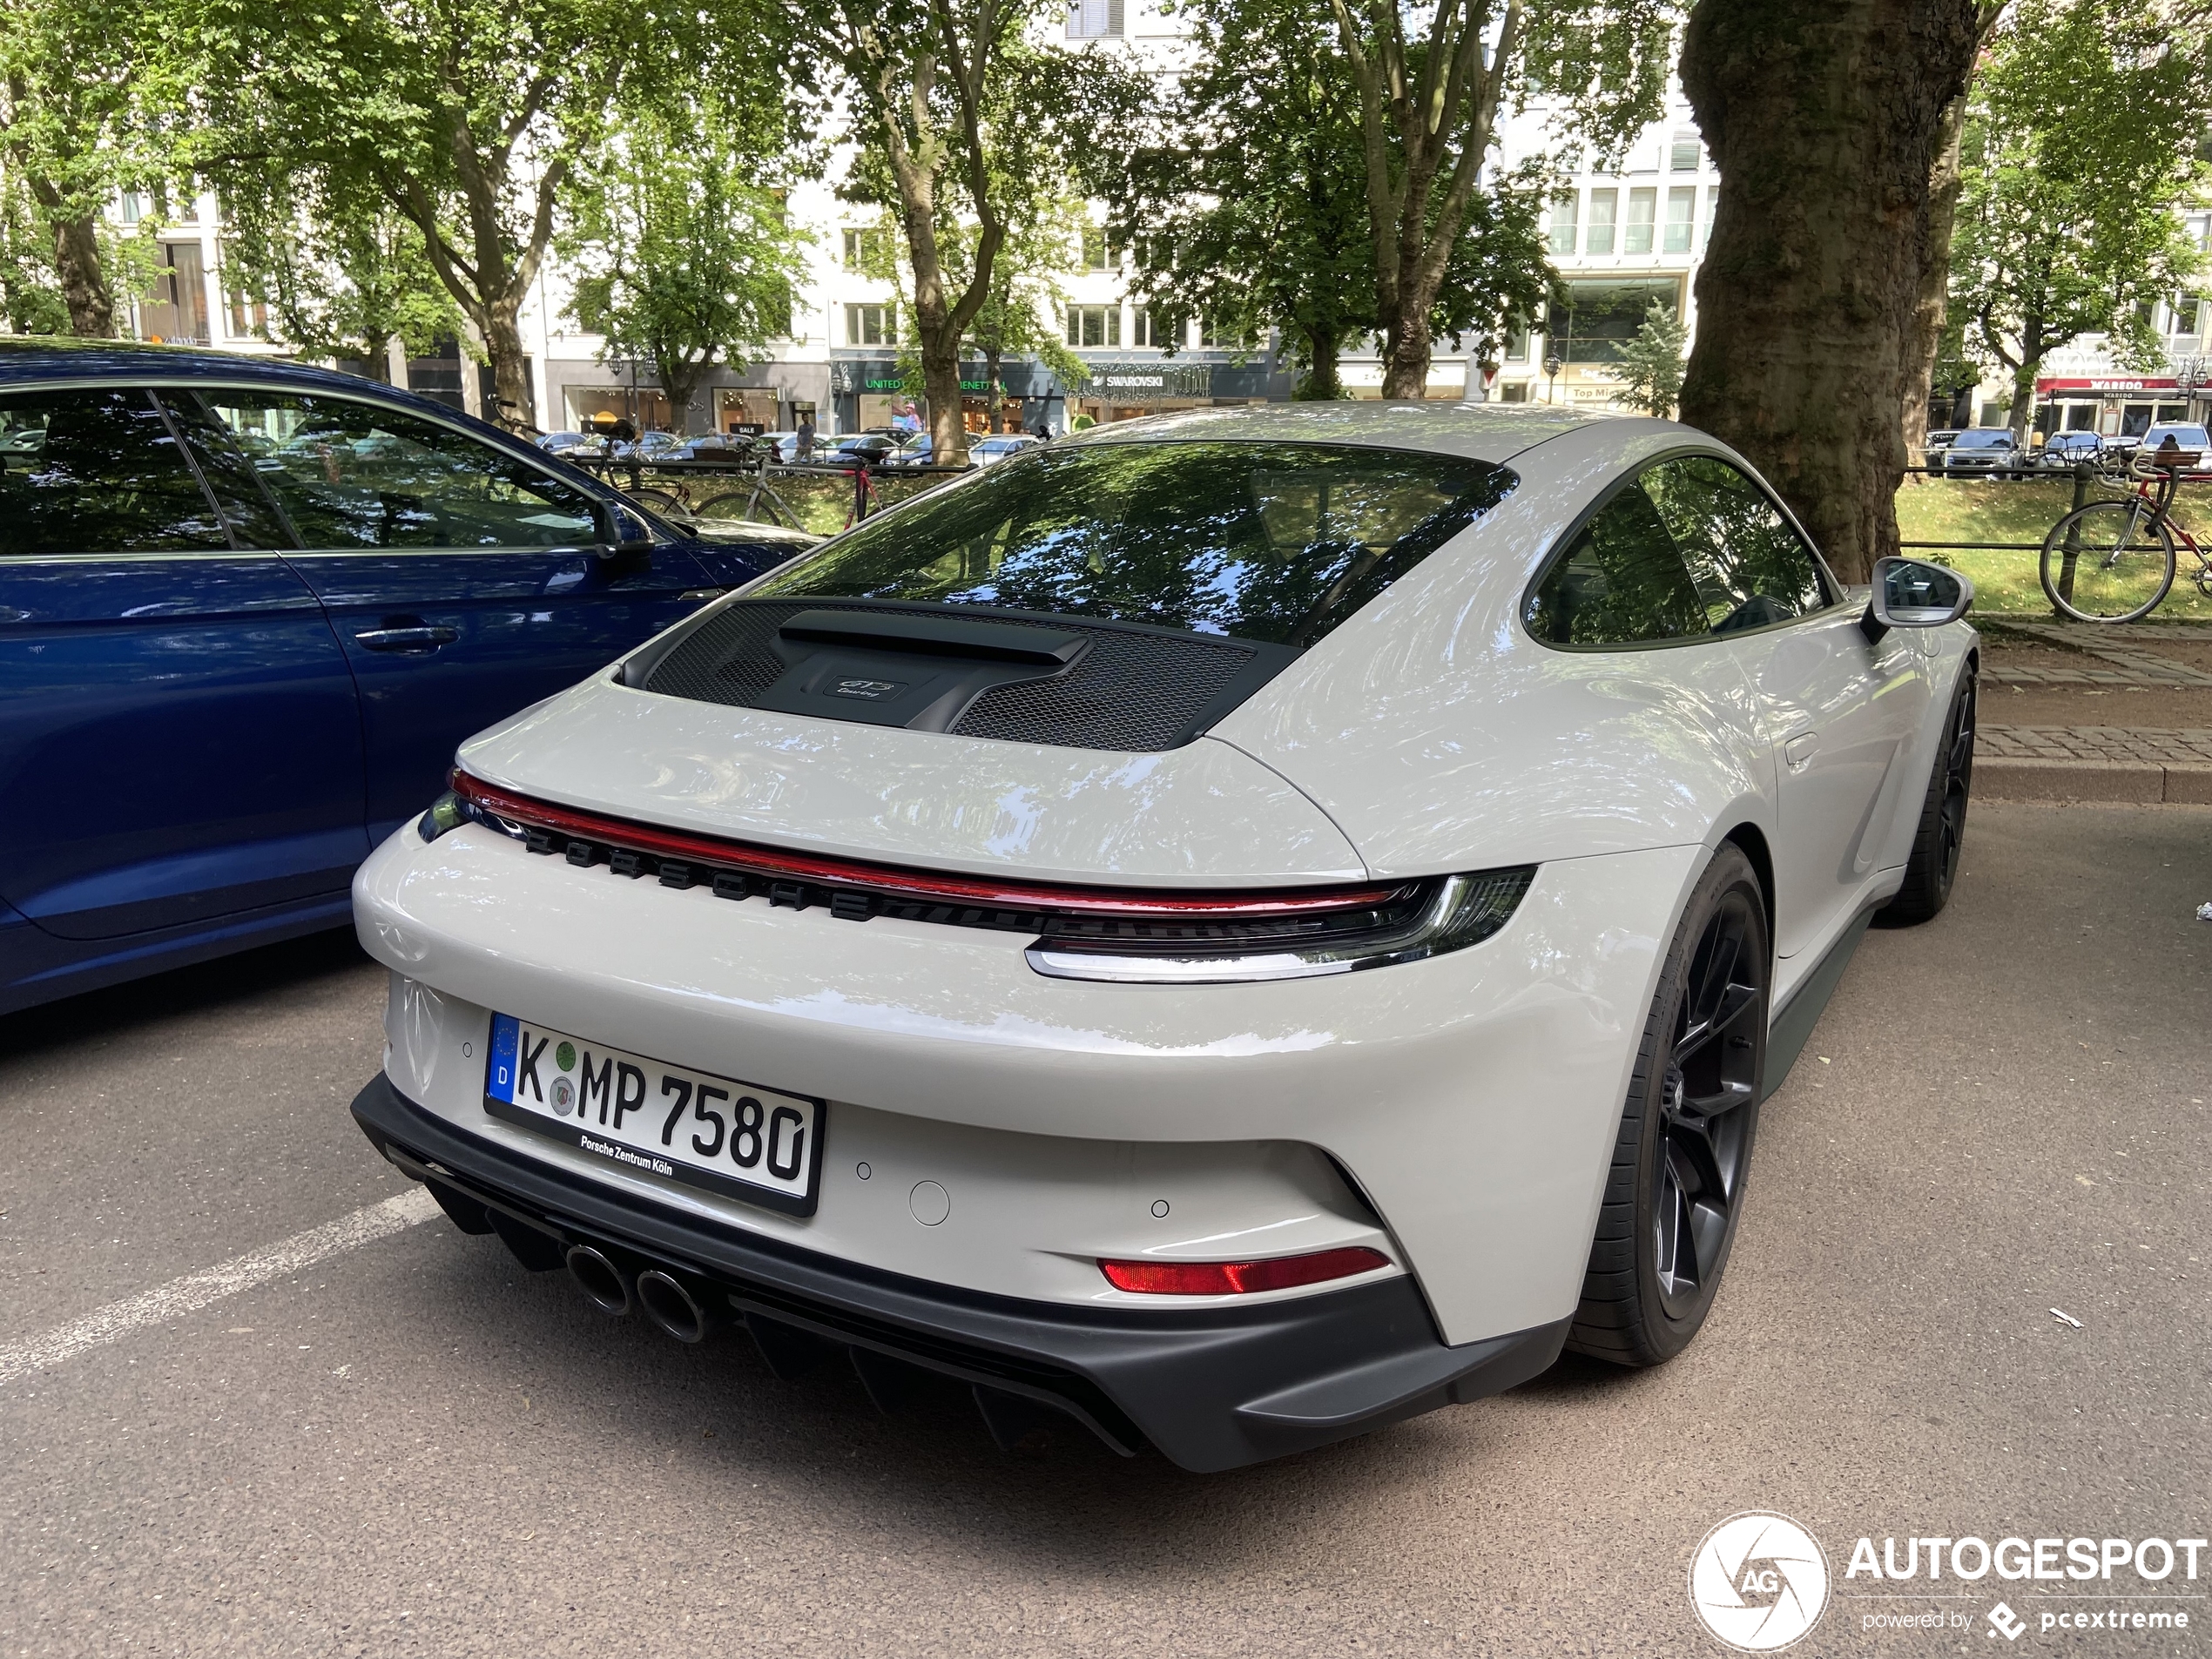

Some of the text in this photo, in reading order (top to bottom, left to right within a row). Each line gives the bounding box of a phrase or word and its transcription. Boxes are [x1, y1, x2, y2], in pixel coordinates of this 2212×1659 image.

[866, 380, 900, 389] UNITED
[1107, 376, 1164, 387] SWAROVSKI
[2091, 380, 2142, 390] MAREDO
[1574, 388, 1593, 399] Top
[526, 831, 873, 921] PORSCHE
[497, 1066, 508, 1085] D
[519, 1031, 549, 1103] K
[577, 1050, 646, 1130] MP
[661, 1075, 805, 1181] 7580
[581, 1135, 672, 1176] Porsche Zentrum Köln
